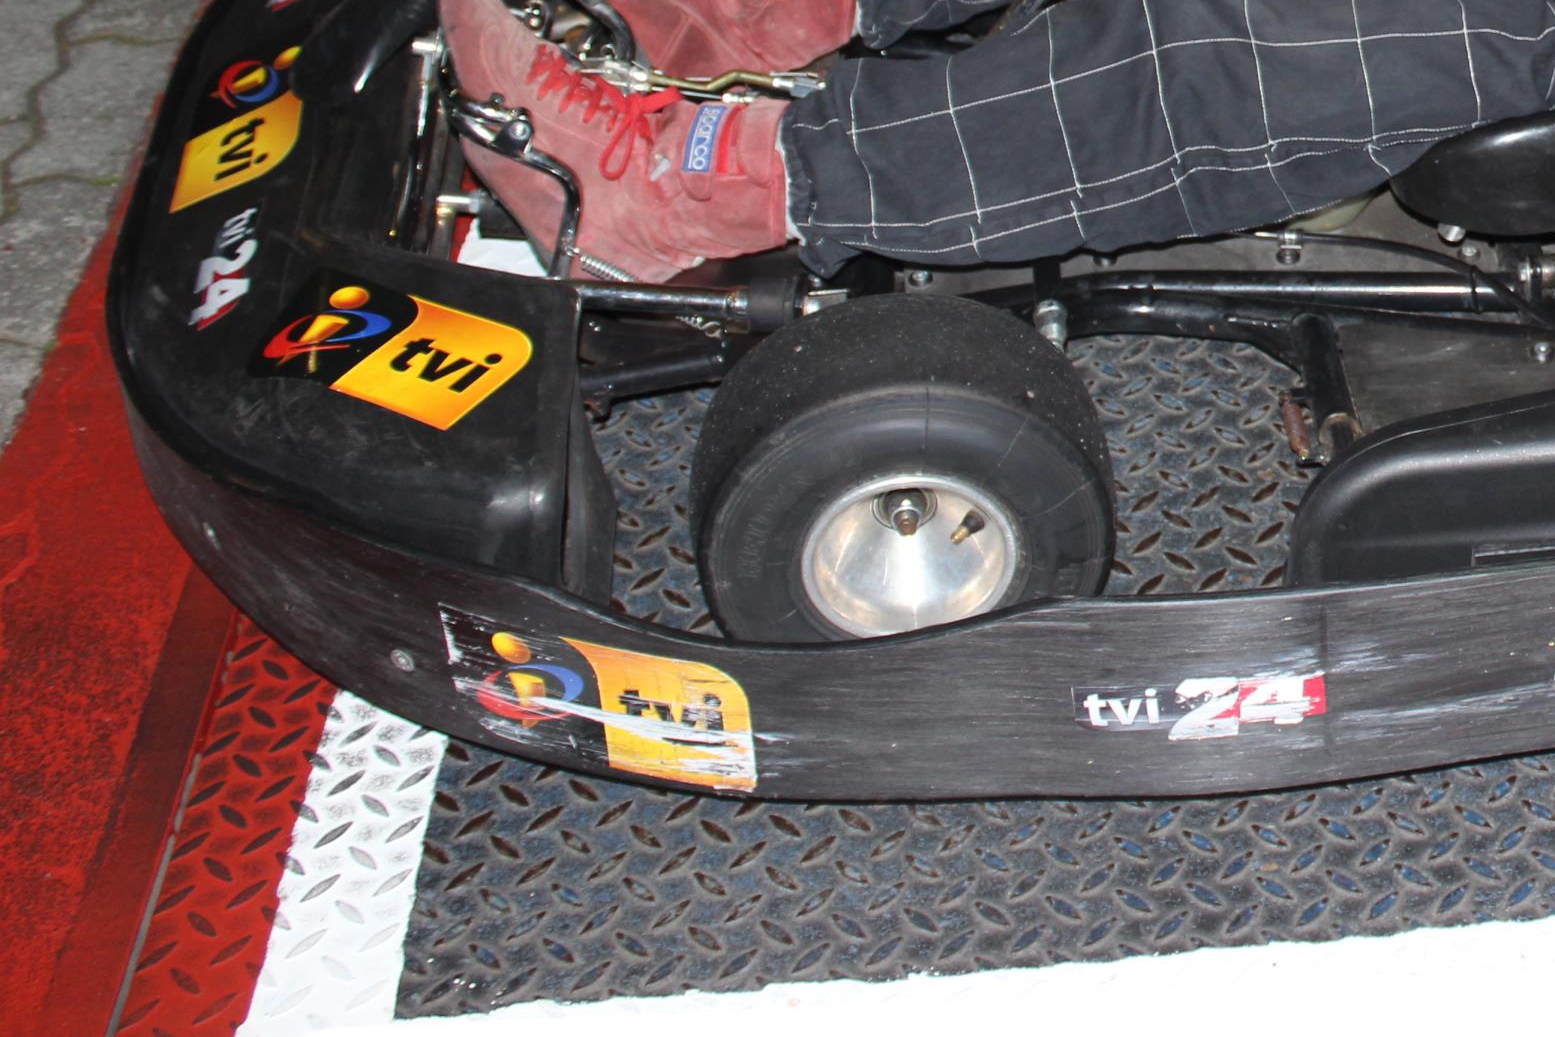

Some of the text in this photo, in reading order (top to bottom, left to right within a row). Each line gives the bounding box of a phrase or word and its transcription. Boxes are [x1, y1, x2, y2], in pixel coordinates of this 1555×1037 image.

[213, 117, 268, 181] tvi
[690, 107, 722, 170] sparco
[188, 207, 258, 326] tvi 24
[389, 338, 503, 394] tvi
[1083, 675, 1314, 741] tvi 24
